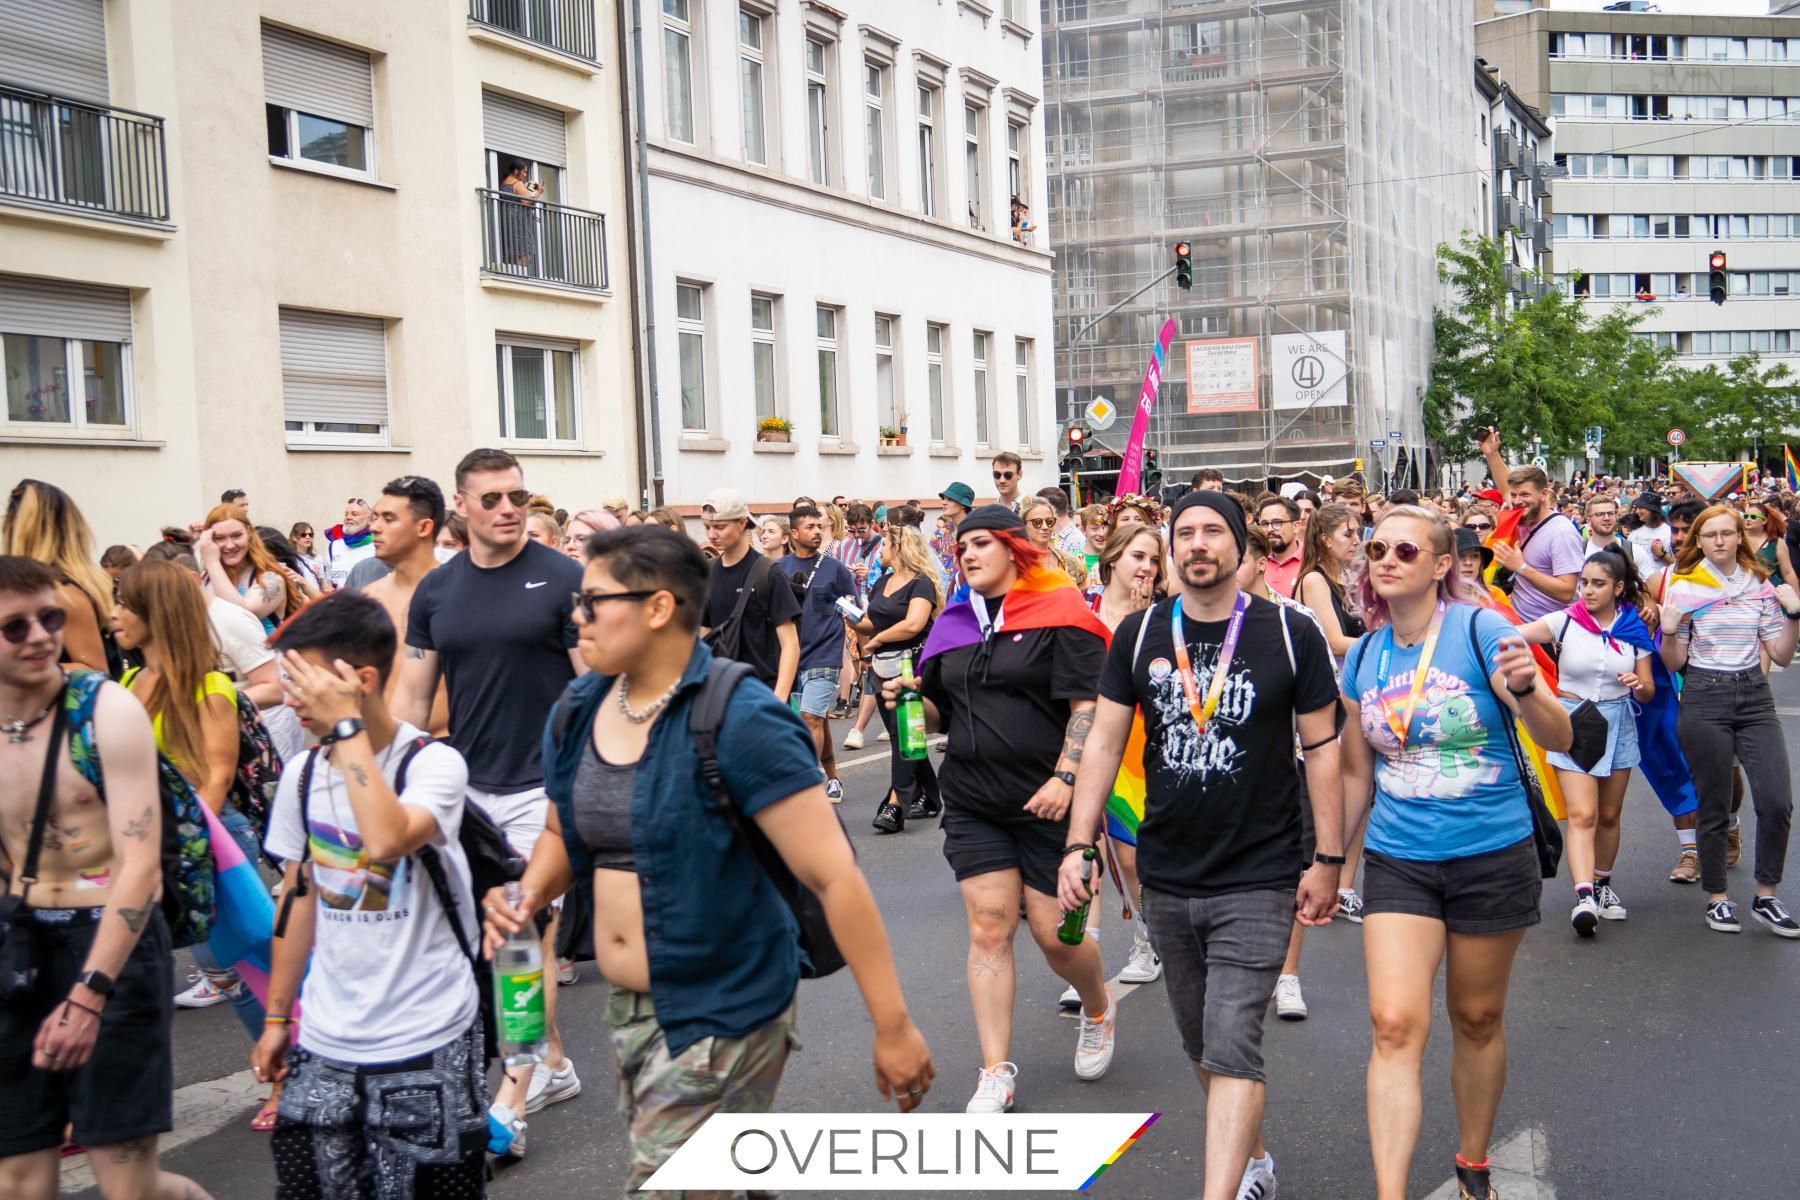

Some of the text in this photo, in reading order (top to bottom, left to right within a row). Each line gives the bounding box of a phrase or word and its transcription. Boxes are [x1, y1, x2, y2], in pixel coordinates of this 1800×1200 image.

[1288, 343, 1328, 355] WE ARE
[1295, 390, 1324, 400] OPEN
